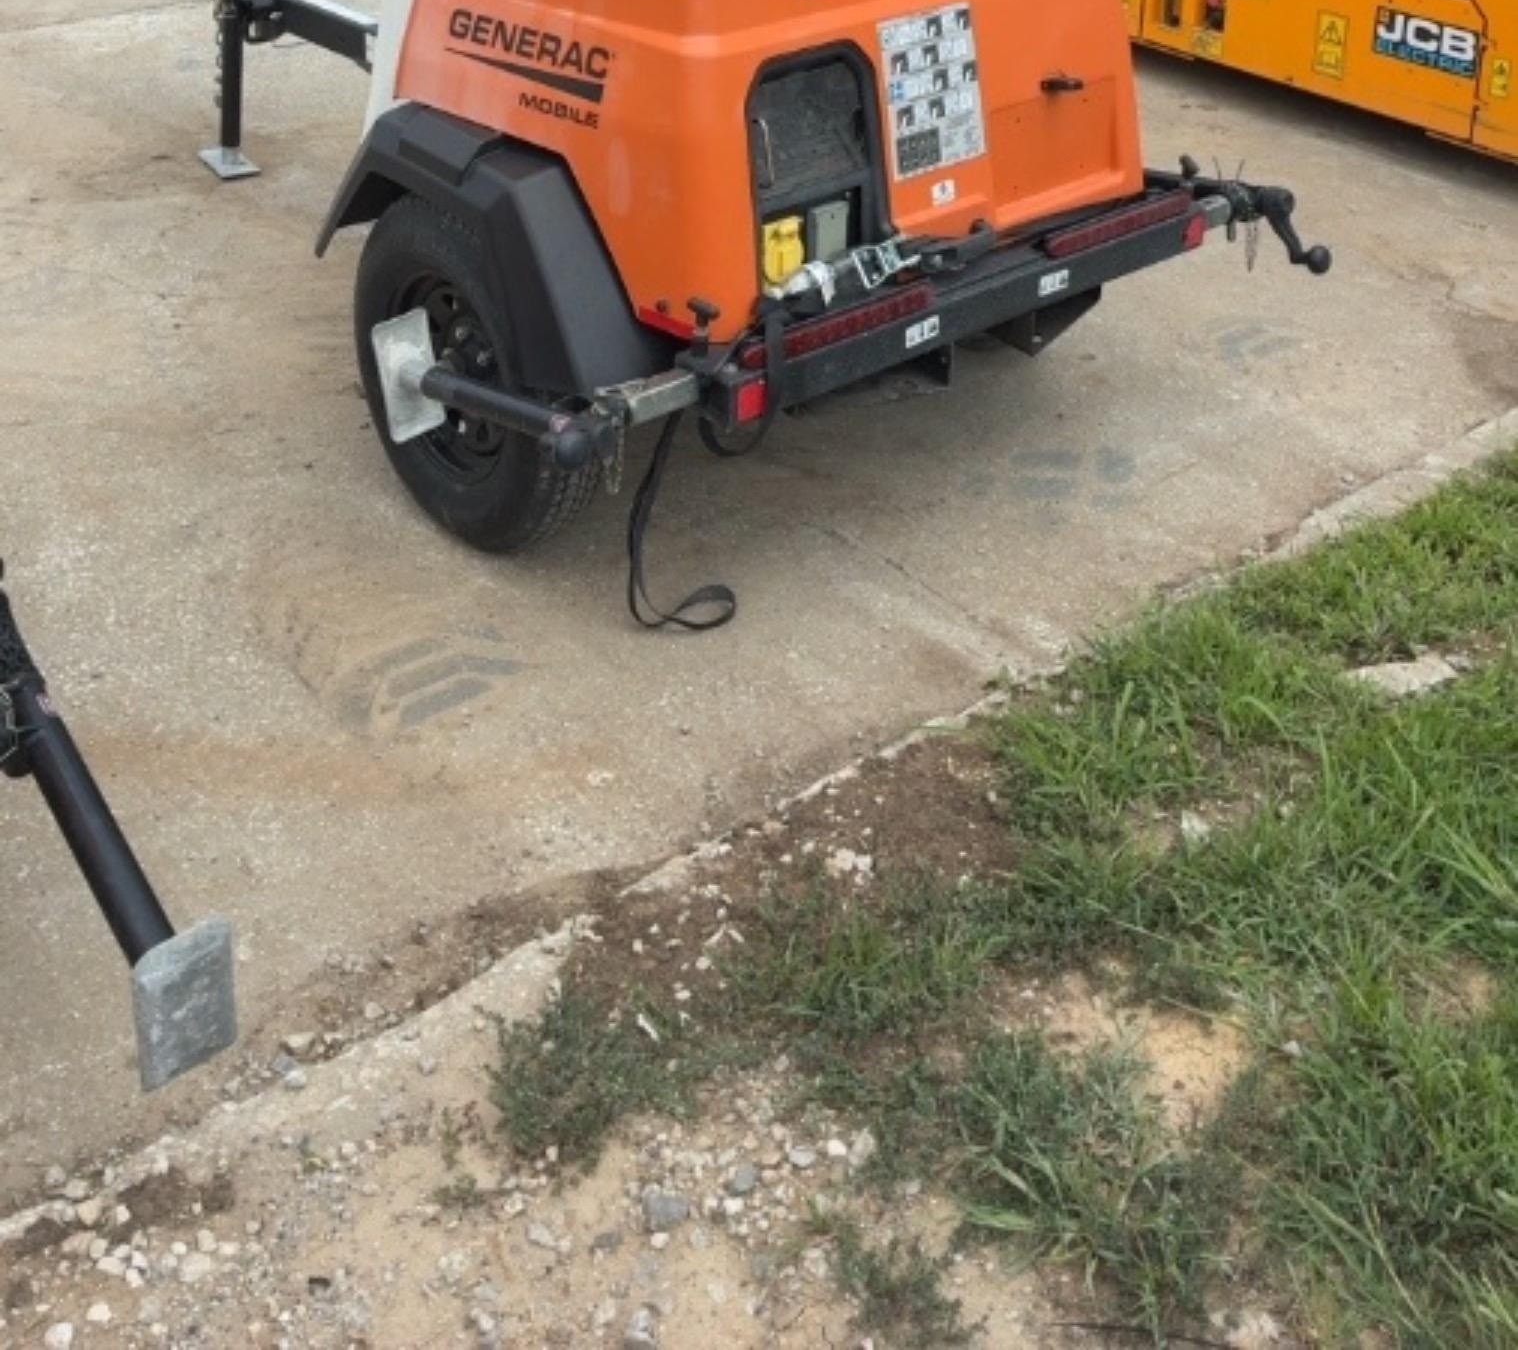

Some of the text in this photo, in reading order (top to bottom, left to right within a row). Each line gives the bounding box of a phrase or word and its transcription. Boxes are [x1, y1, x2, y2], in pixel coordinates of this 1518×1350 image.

[449, 9, 609, 80] GENERAC
[1377, 14, 1476, 62] JCB
[518, 93, 600, 129] MOBILE
